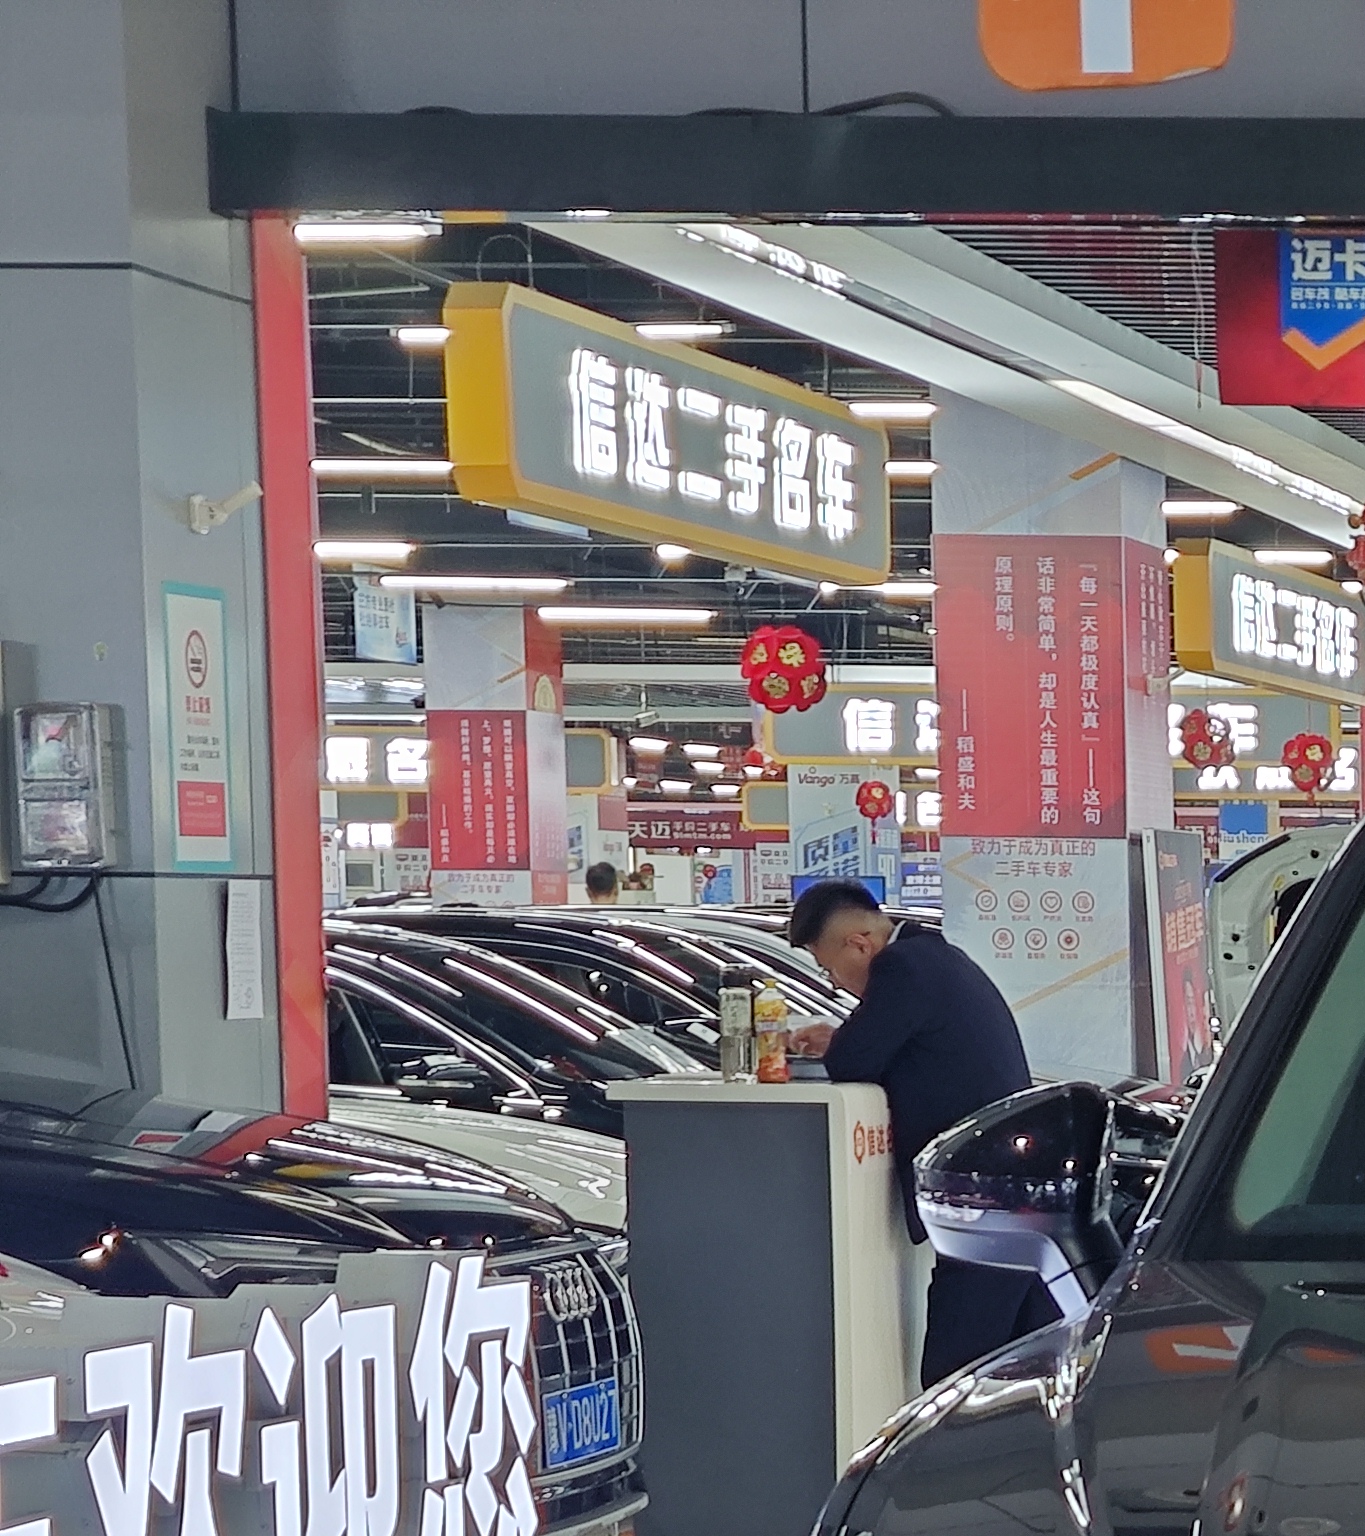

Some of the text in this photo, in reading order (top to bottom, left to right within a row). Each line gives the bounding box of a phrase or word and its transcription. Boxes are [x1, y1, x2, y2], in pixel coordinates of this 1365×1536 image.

[568, 347, 858, 540] 信达二手名车
[628, 821, 671, 840] 天迈
[971, 839, 1096, 857] 致力于成为真正的
[995, 860, 1073, 878] 二手车专家
